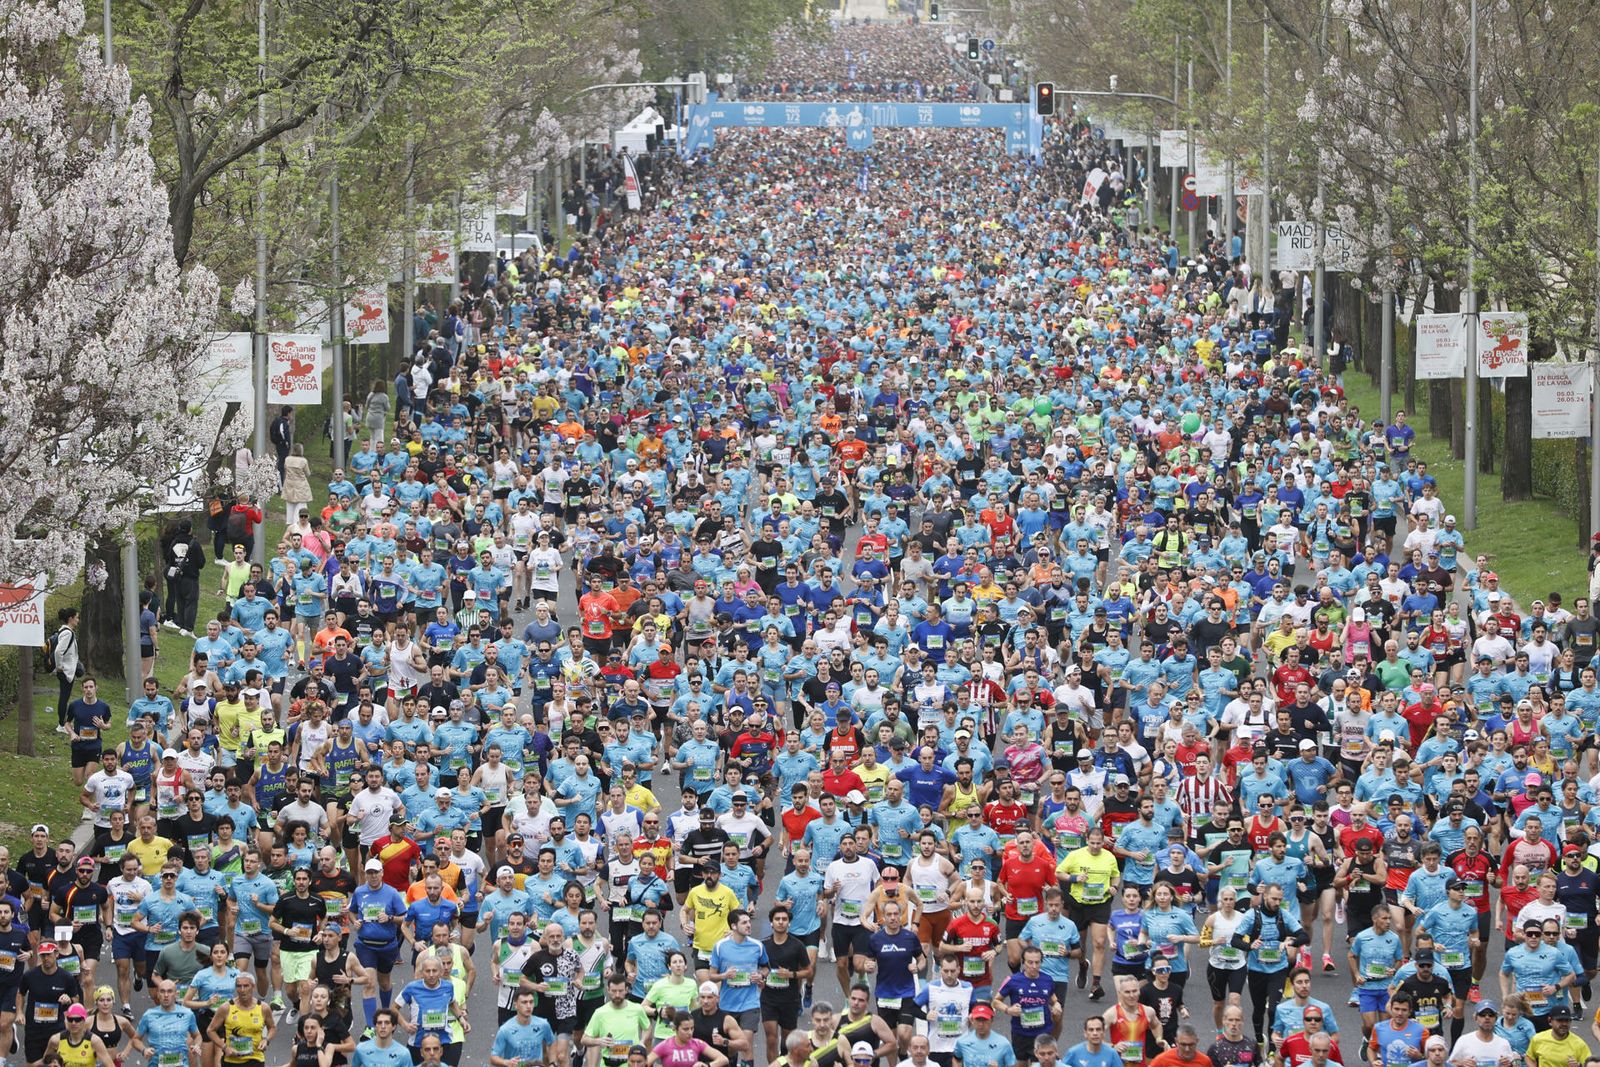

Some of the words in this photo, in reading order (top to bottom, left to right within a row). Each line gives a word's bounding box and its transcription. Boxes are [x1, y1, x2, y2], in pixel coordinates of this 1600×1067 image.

[463, 209, 488, 220] CUL
[466, 221, 484, 231] TU
[1280, 225, 1313, 237] MAD
[475, 232, 494, 243] RA
[1291, 238, 1313, 249] RID
[287, 375, 317, 383] BUSCA
[298, 383, 319, 391] VIDA
[10, 613, 41, 624] VIDA
[672, 1049, 696, 1062] ALE
